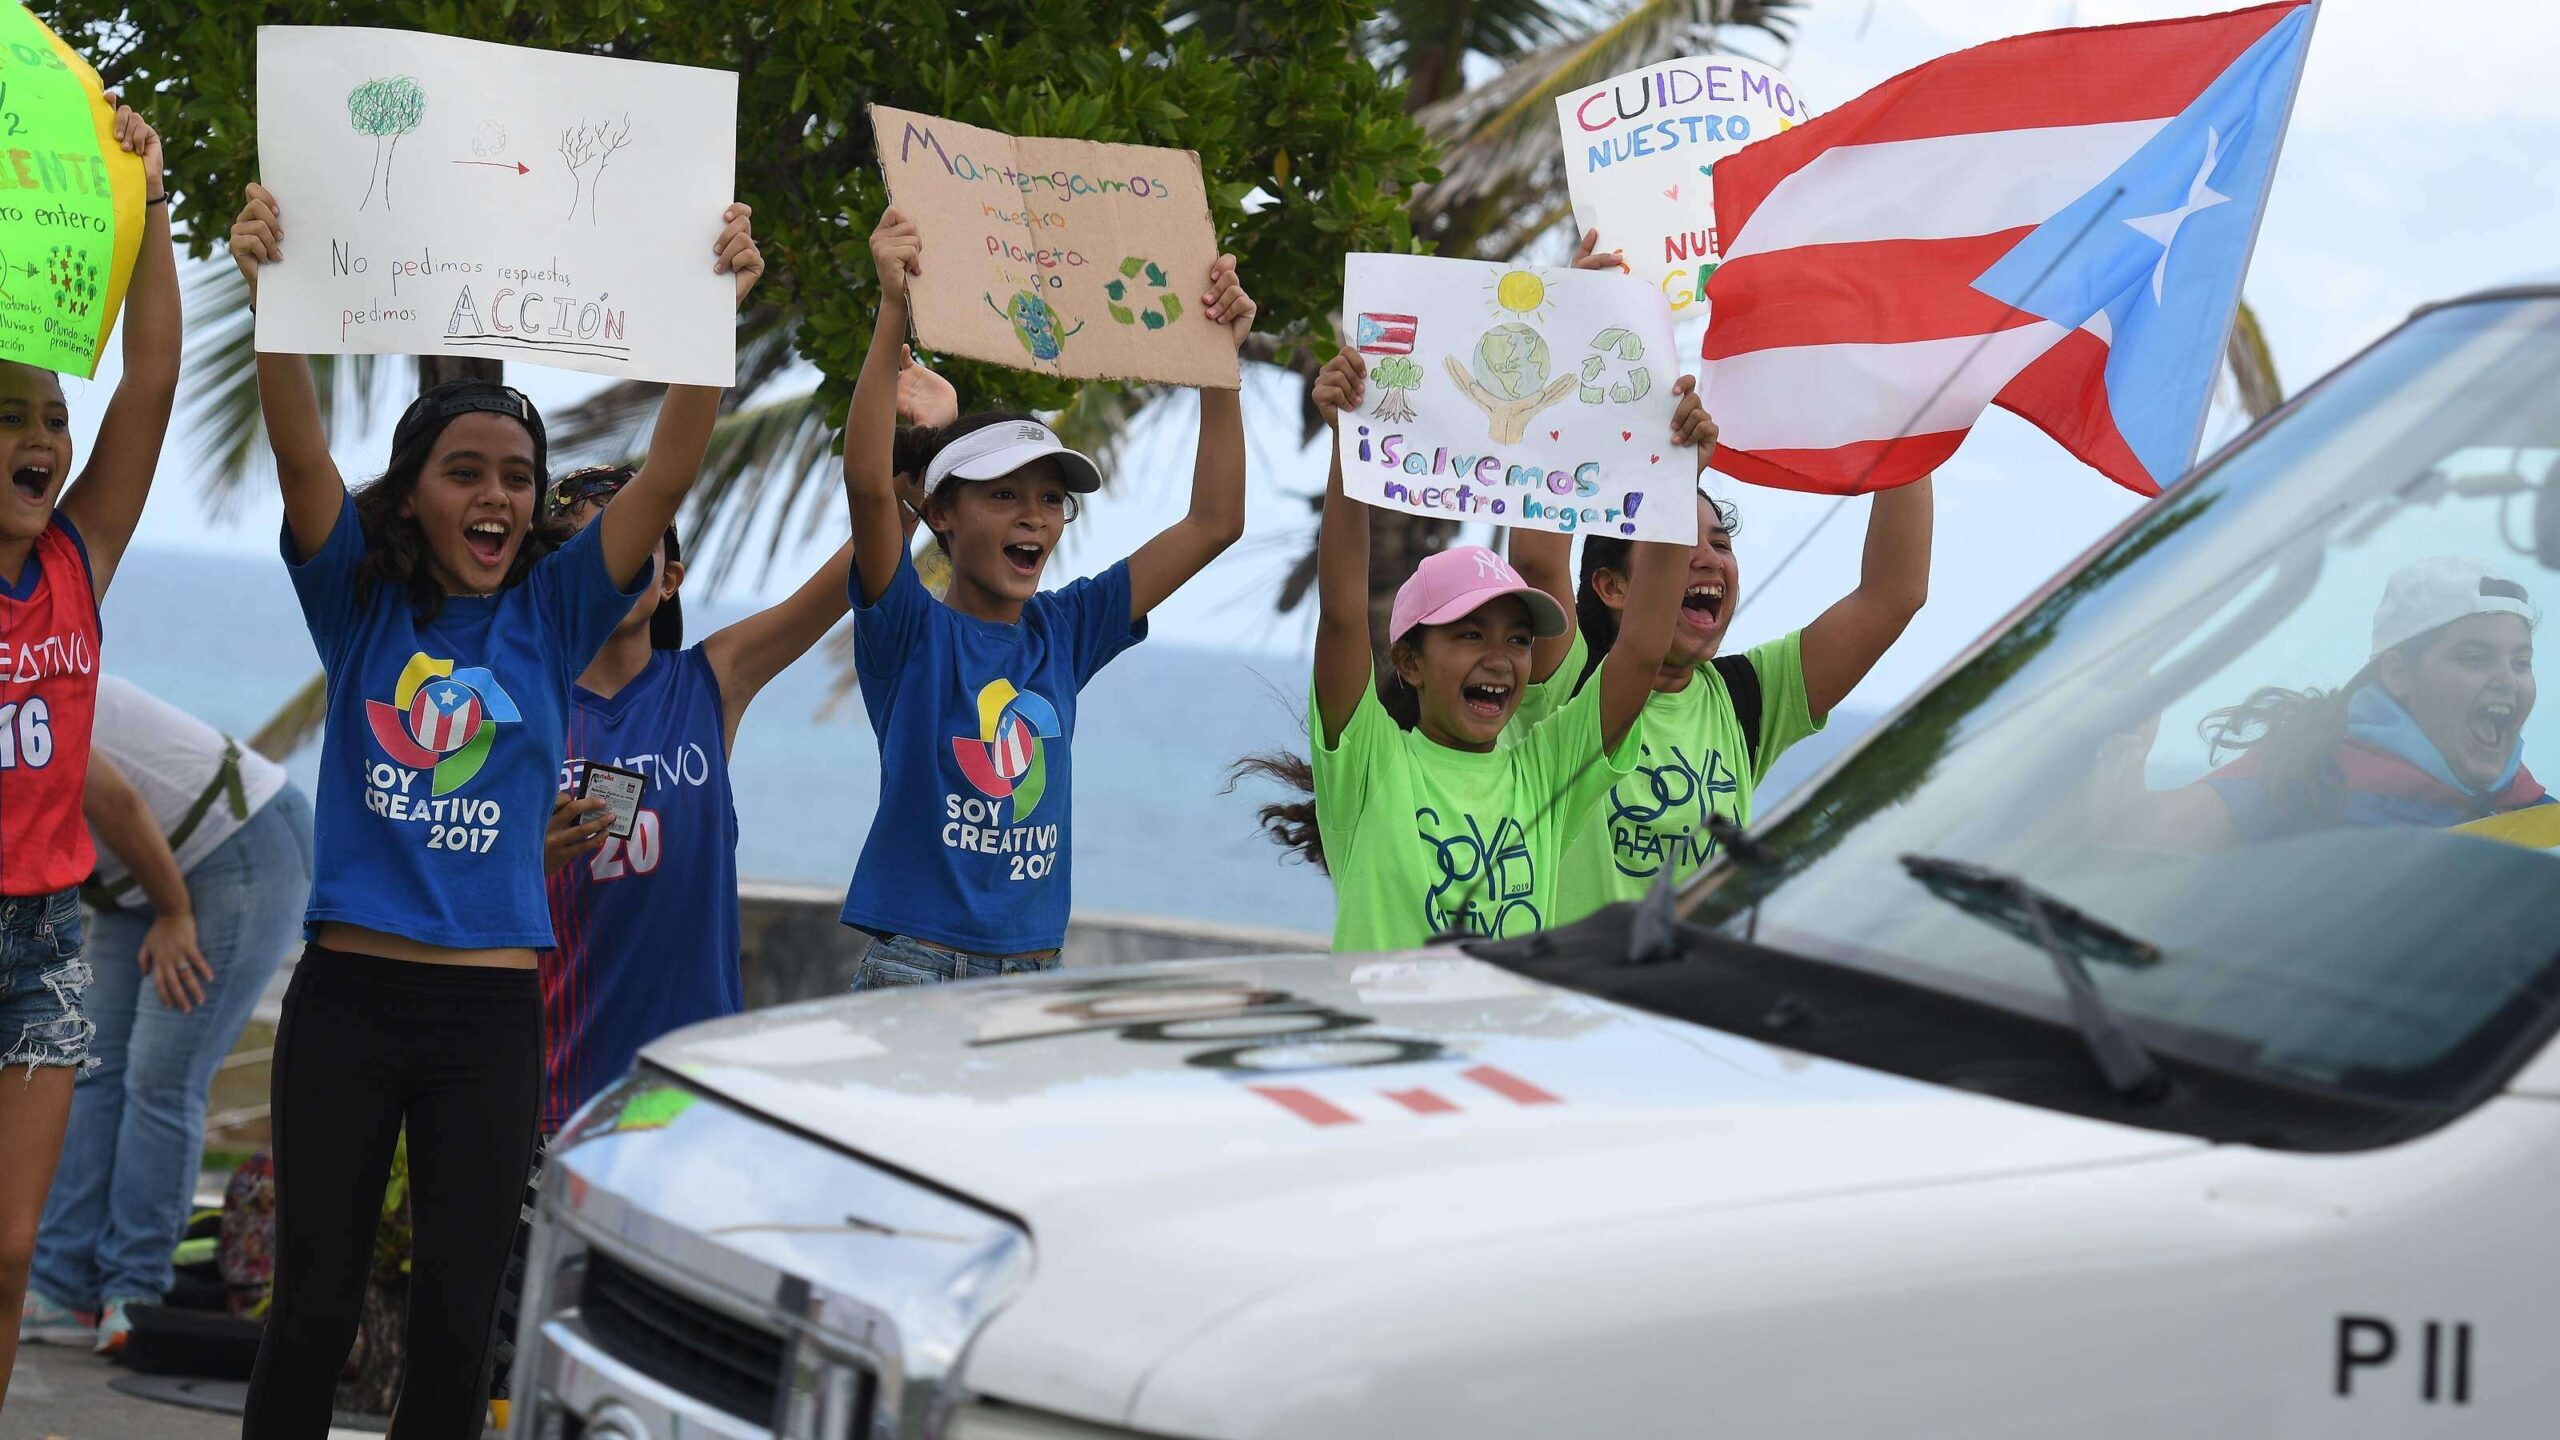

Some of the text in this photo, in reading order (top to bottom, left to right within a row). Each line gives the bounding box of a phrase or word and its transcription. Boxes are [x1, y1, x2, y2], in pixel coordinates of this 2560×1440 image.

[0, 42, 68, 71] OS
[1588, 114, 1750, 173] NUESTRO
[901, 121, 1168, 203] Mantengamos
[35, 203, 107, 233] entero
[982, 202, 1066, 230] nuestro
[332, 238, 368, 277] No
[392, 247, 484, 297] pedimos
[342, 284, 625, 343] pedimos ACCIÓN
[1384, 480, 1644, 536] nuestro hogar!
[365, 758, 418, 794] SOY
[365, 786, 501, 827] CREATIVO
[946, 793, 1002, 827] SOY
[427, 824, 499, 854] 2017
[942, 821, 1058, 855] CREATIVO
[1511, 882, 1530, 893] 2019
